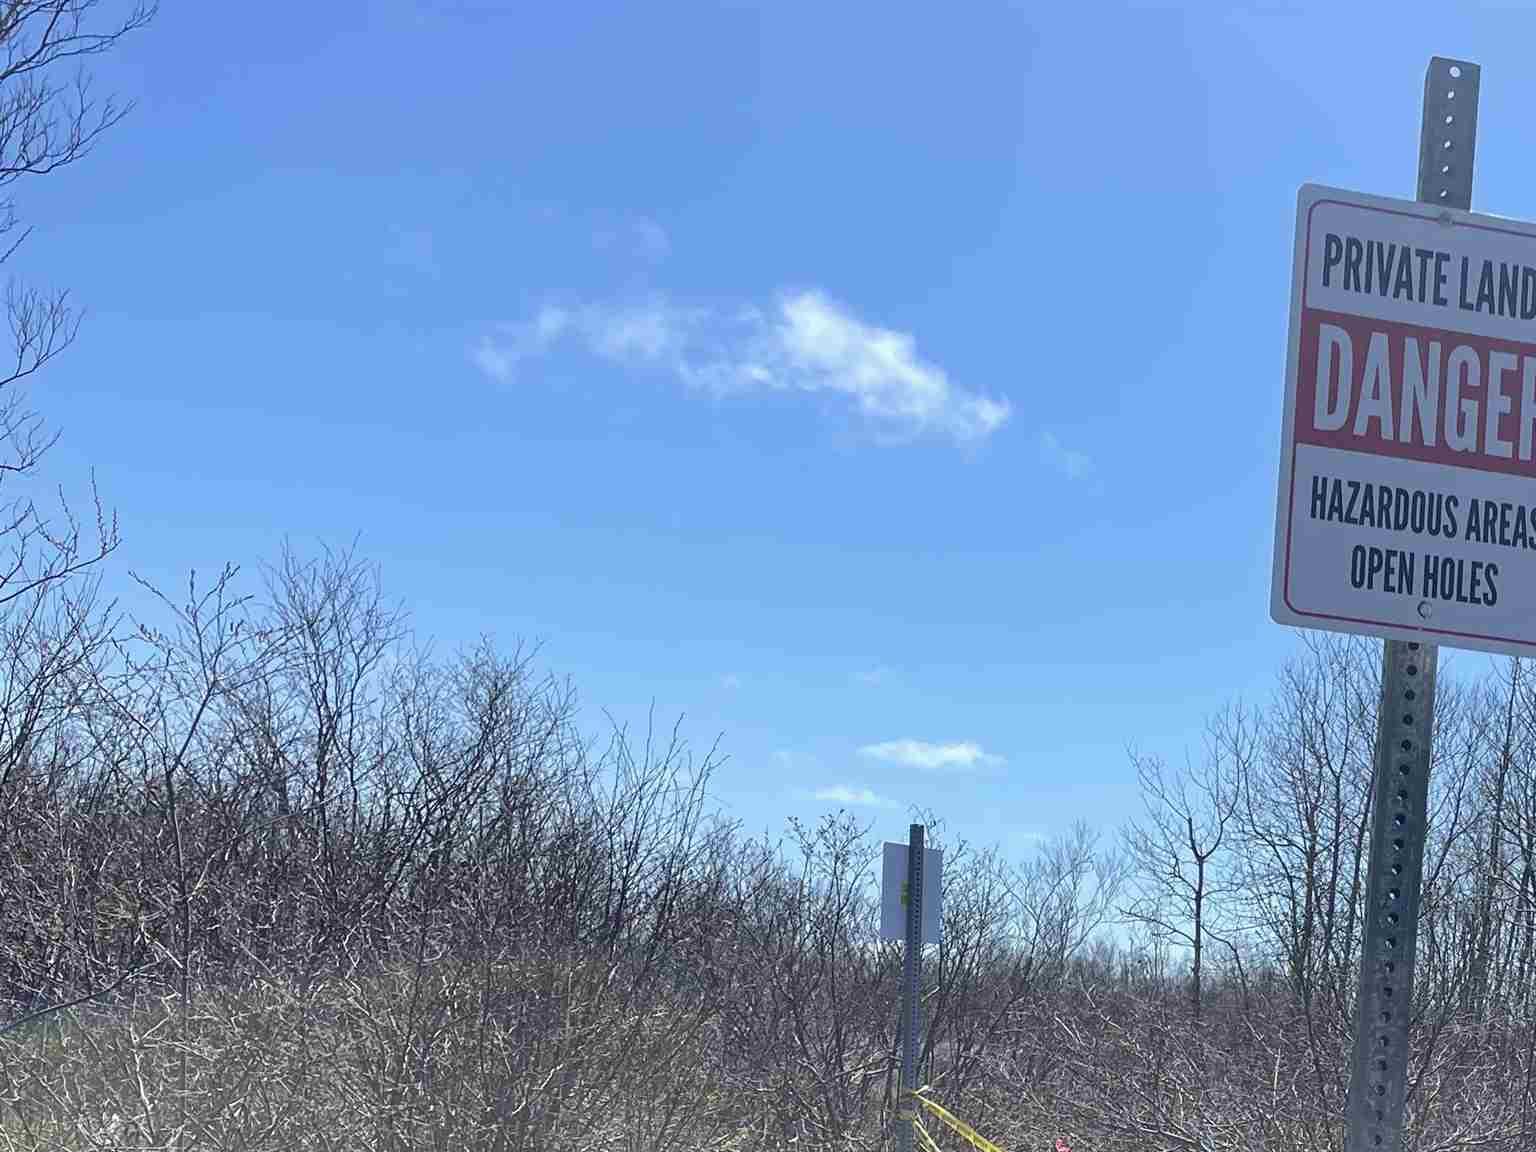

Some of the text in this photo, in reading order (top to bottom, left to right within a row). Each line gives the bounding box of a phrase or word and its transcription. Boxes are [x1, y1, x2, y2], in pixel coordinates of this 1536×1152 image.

[1322, 233, 1451, 307] PRIVATE
[1310, 475, 1458, 539] HAZARDOUS
[1350, 544, 1499, 607] OPEN HOLES
